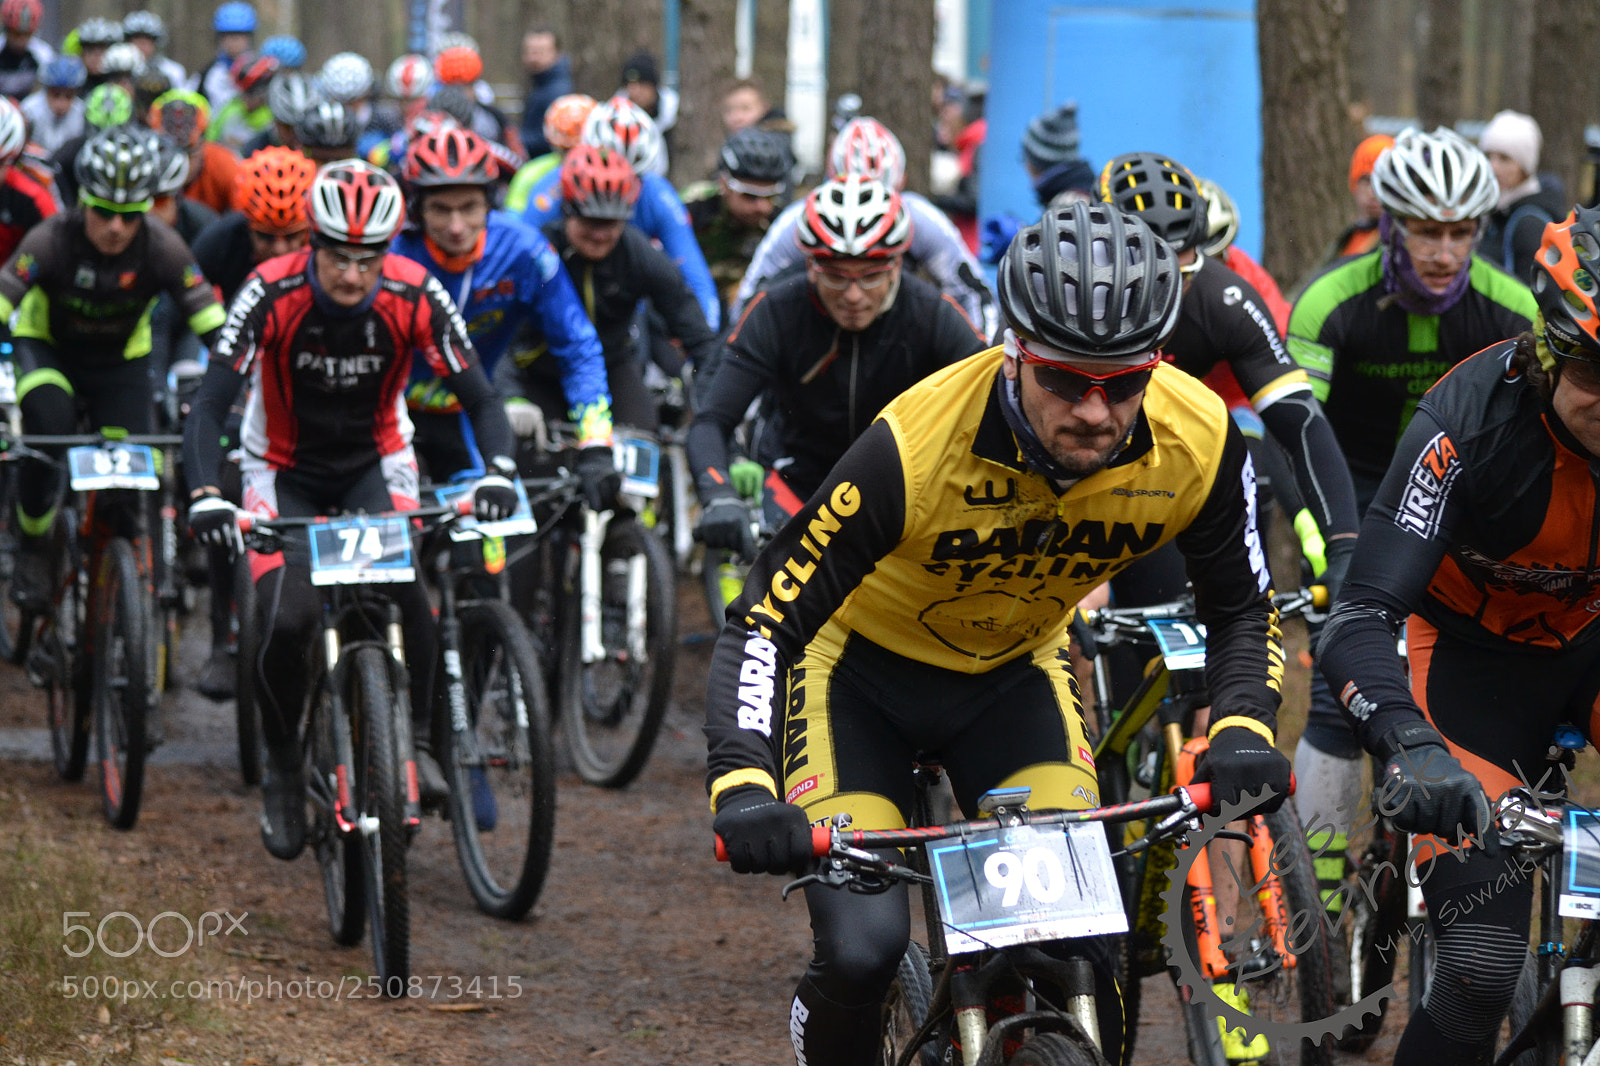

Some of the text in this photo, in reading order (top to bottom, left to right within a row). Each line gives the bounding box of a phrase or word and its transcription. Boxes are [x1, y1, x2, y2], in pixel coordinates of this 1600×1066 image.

[217, 277, 266, 356] PATNET
[1242, 299, 1291, 365] RENAULT
[338, 526, 383, 563] 74
[930, 518, 1166, 562] BARAN
[737, 630, 778, 738] BARA
[785, 779, 814, 805] REND
[983, 847, 1066, 908] 90
[1191, 899, 1210, 938] FOX
